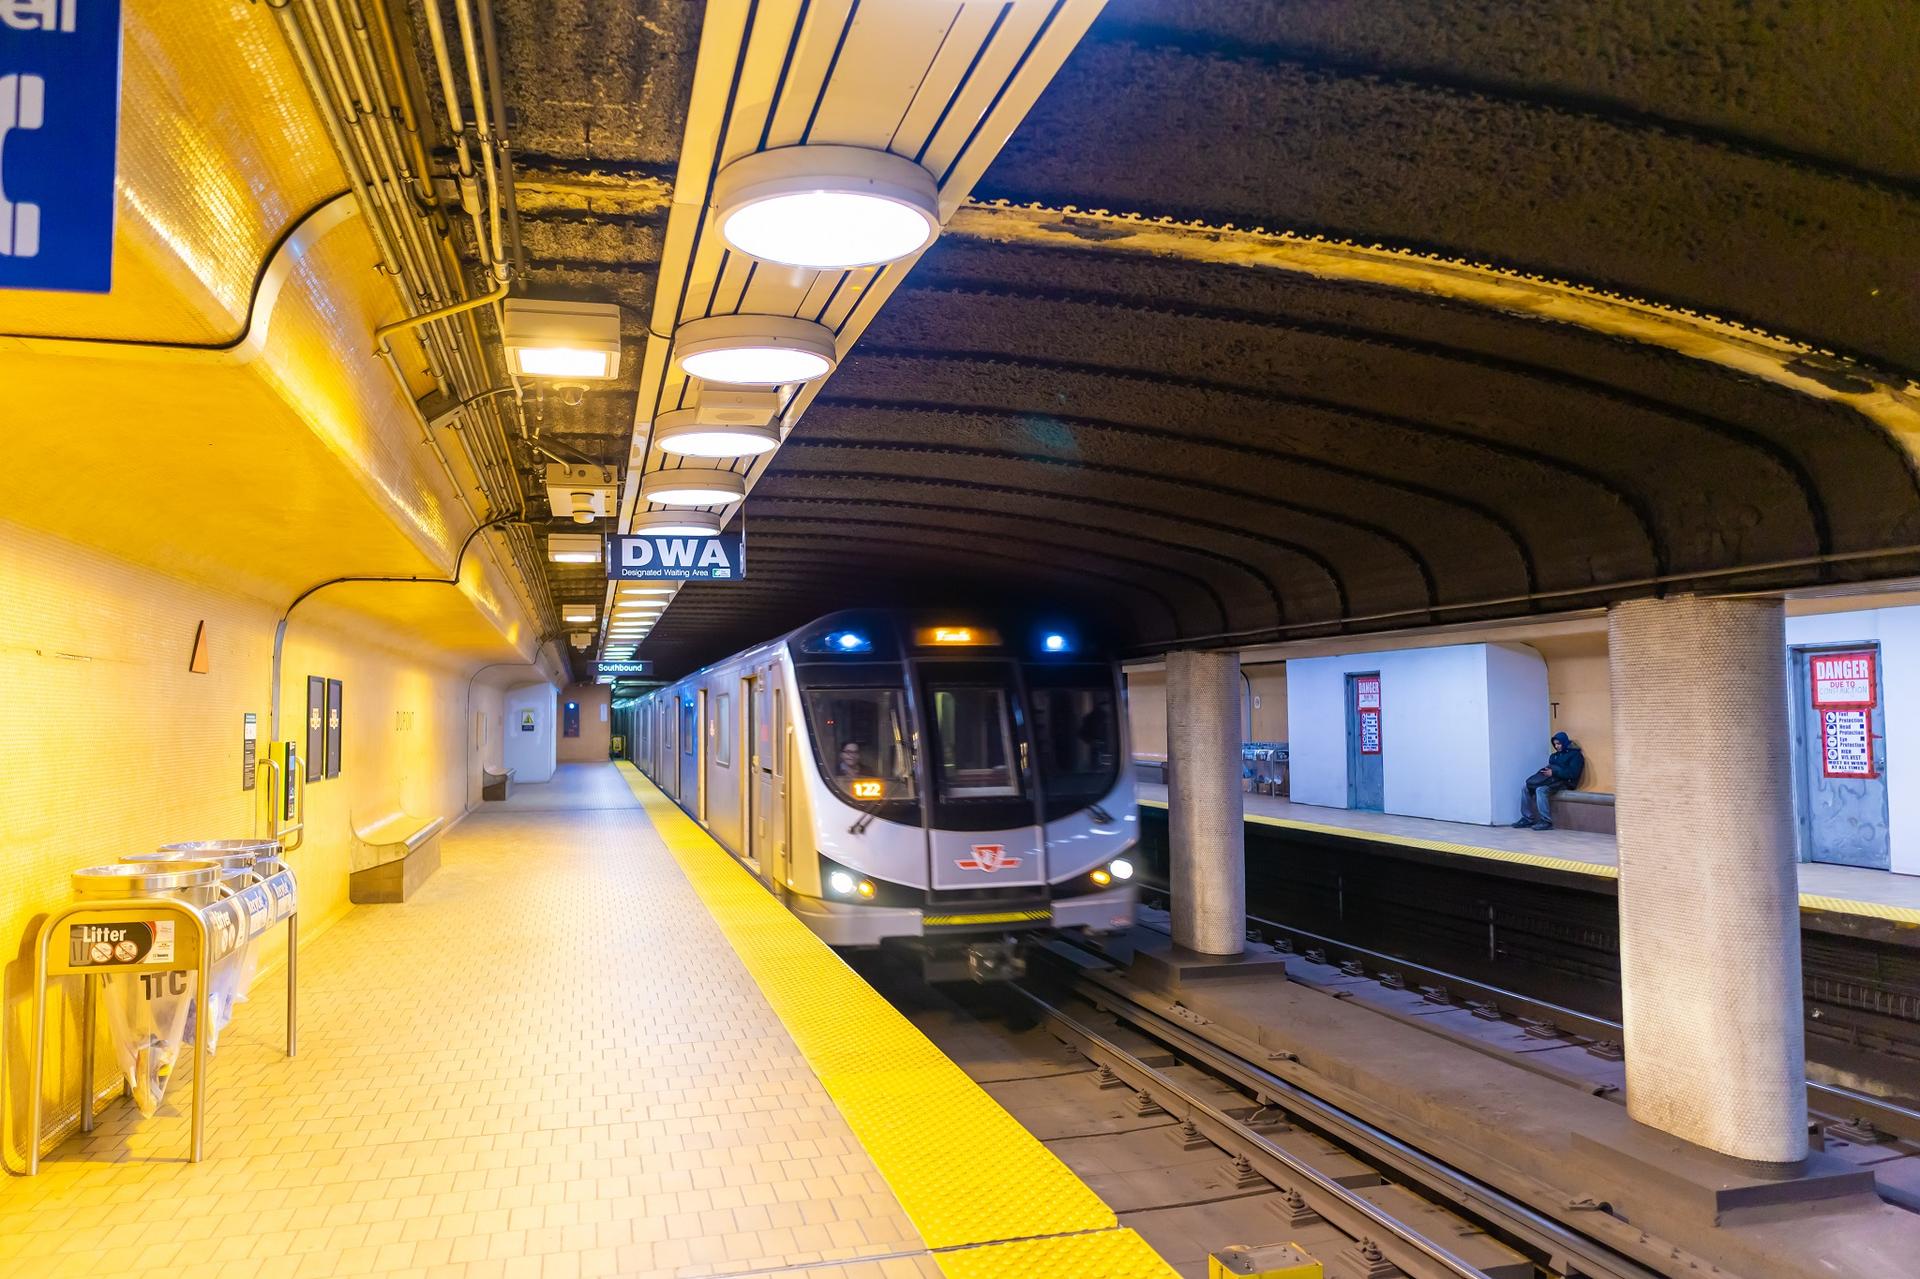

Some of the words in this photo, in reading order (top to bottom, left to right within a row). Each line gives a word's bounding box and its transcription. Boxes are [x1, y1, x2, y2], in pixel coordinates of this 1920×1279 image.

[622, 538, 730, 567] DWA
[622, 568, 662, 578] Designated
[663, 569, 690, 578] Waiting
[598, 663, 643, 672] Southbound
[1816, 659, 1869, 680] DANGER
[854, 783, 881, 797] 122
[83, 926, 127, 943] Litter
